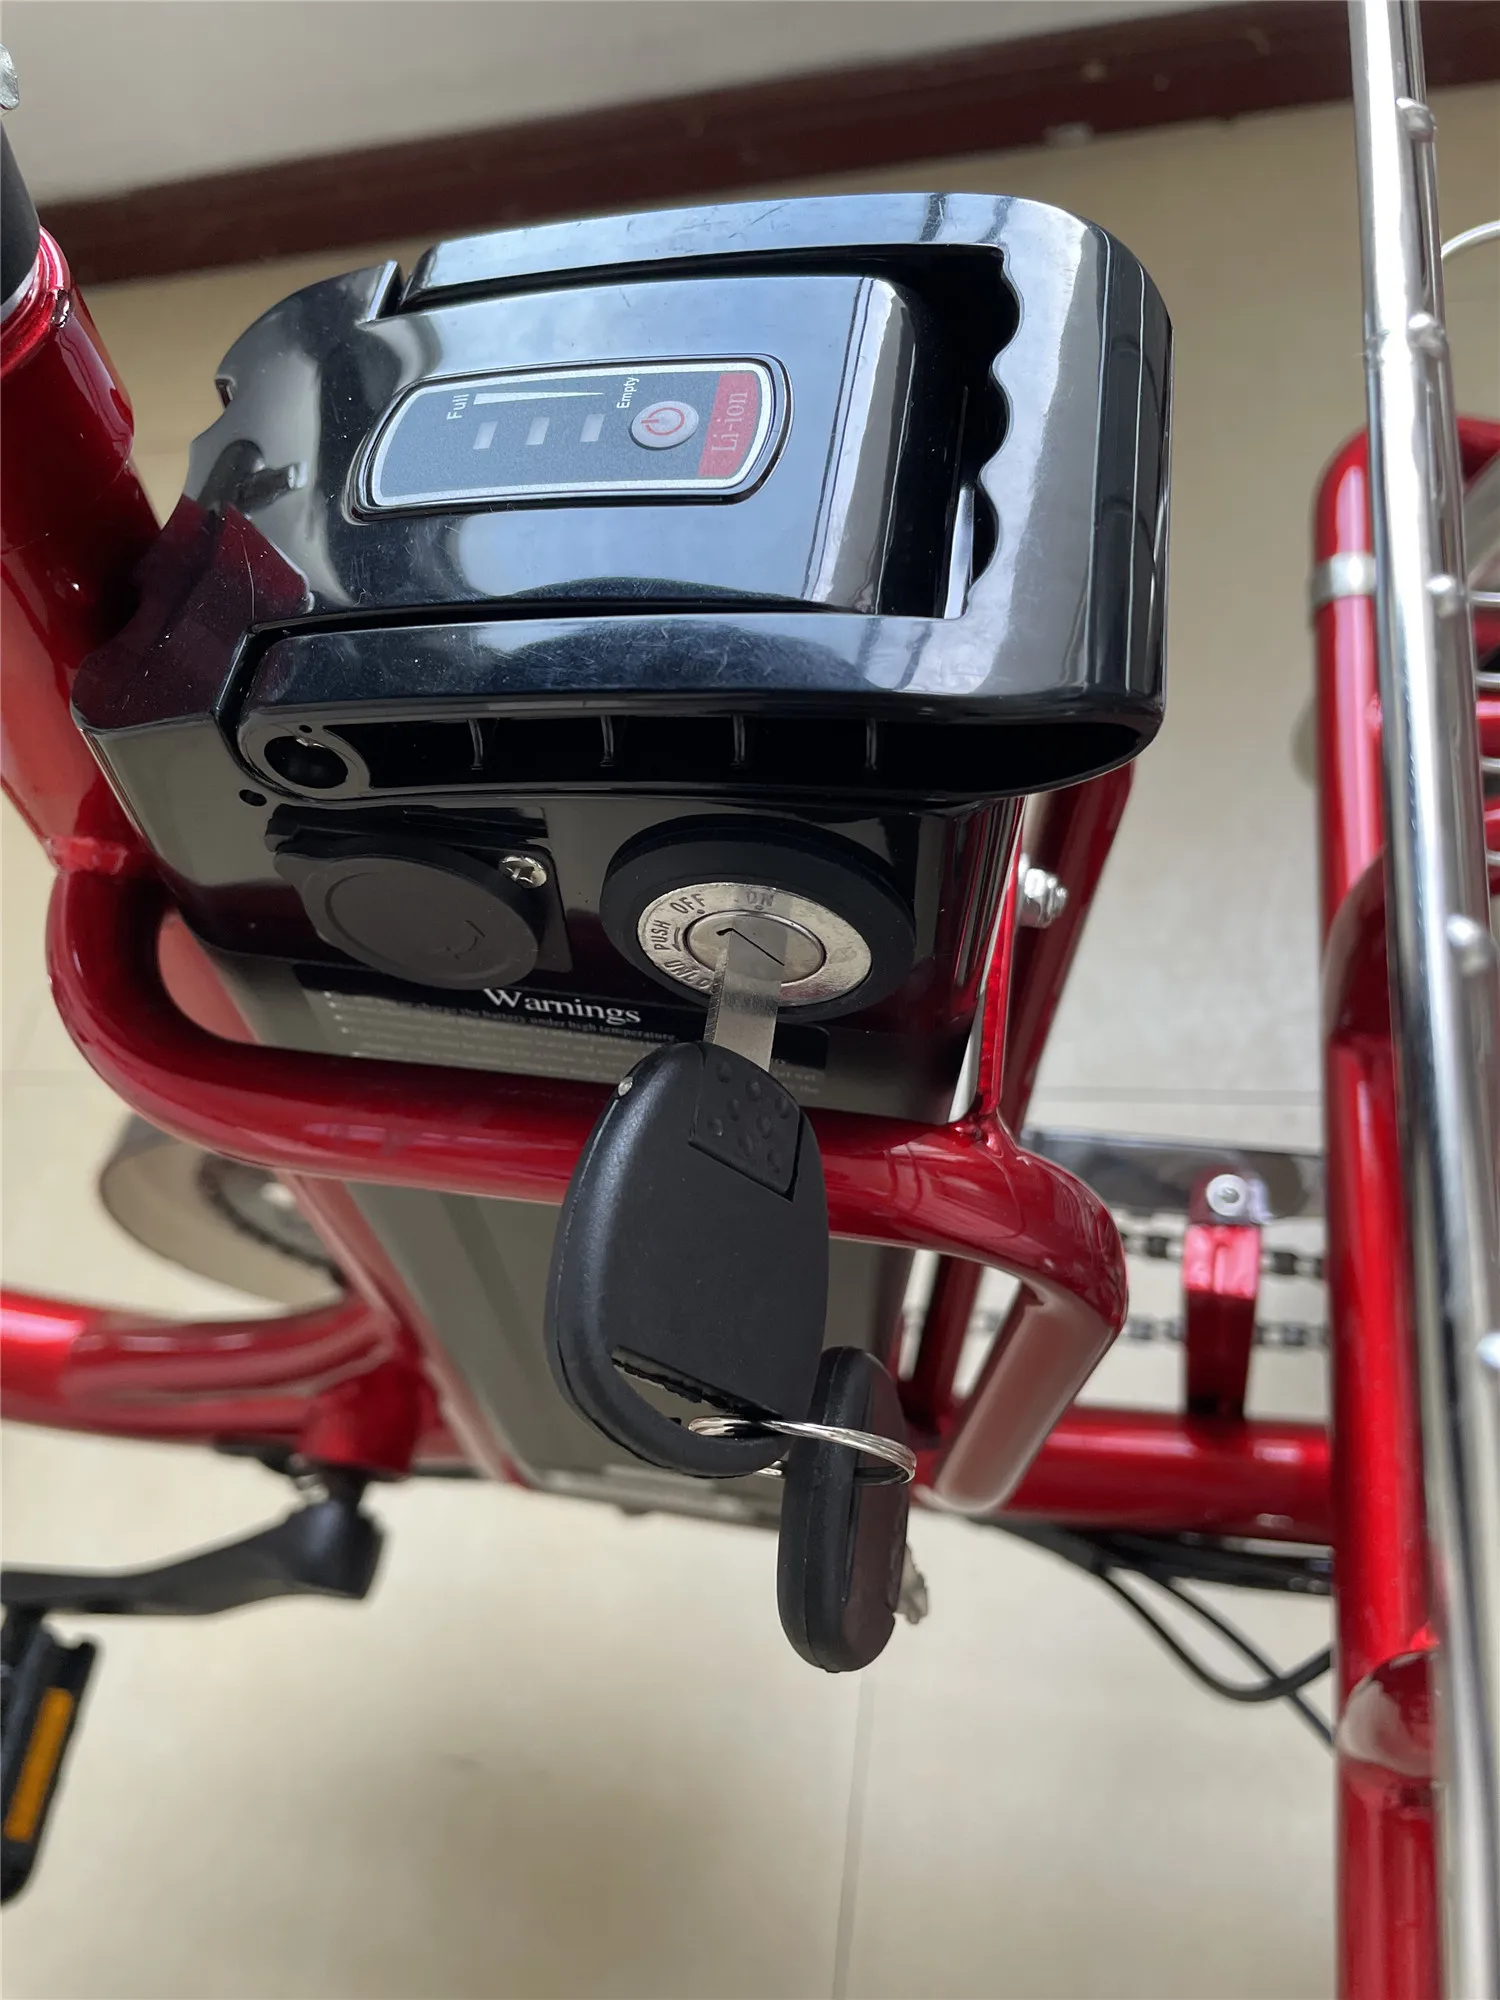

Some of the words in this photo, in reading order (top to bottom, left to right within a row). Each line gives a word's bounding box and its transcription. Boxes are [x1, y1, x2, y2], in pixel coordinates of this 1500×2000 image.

[446, 393, 470, 421] Full
[616, 376, 640, 410] Empty
[711, 391, 748, 453] Li-ion
[670, 893, 706, 914] OFF
[747, 891, 774, 907] ON
[650, 919, 672, 951] PUSH
[483, 987, 641, 1026] Warnings
